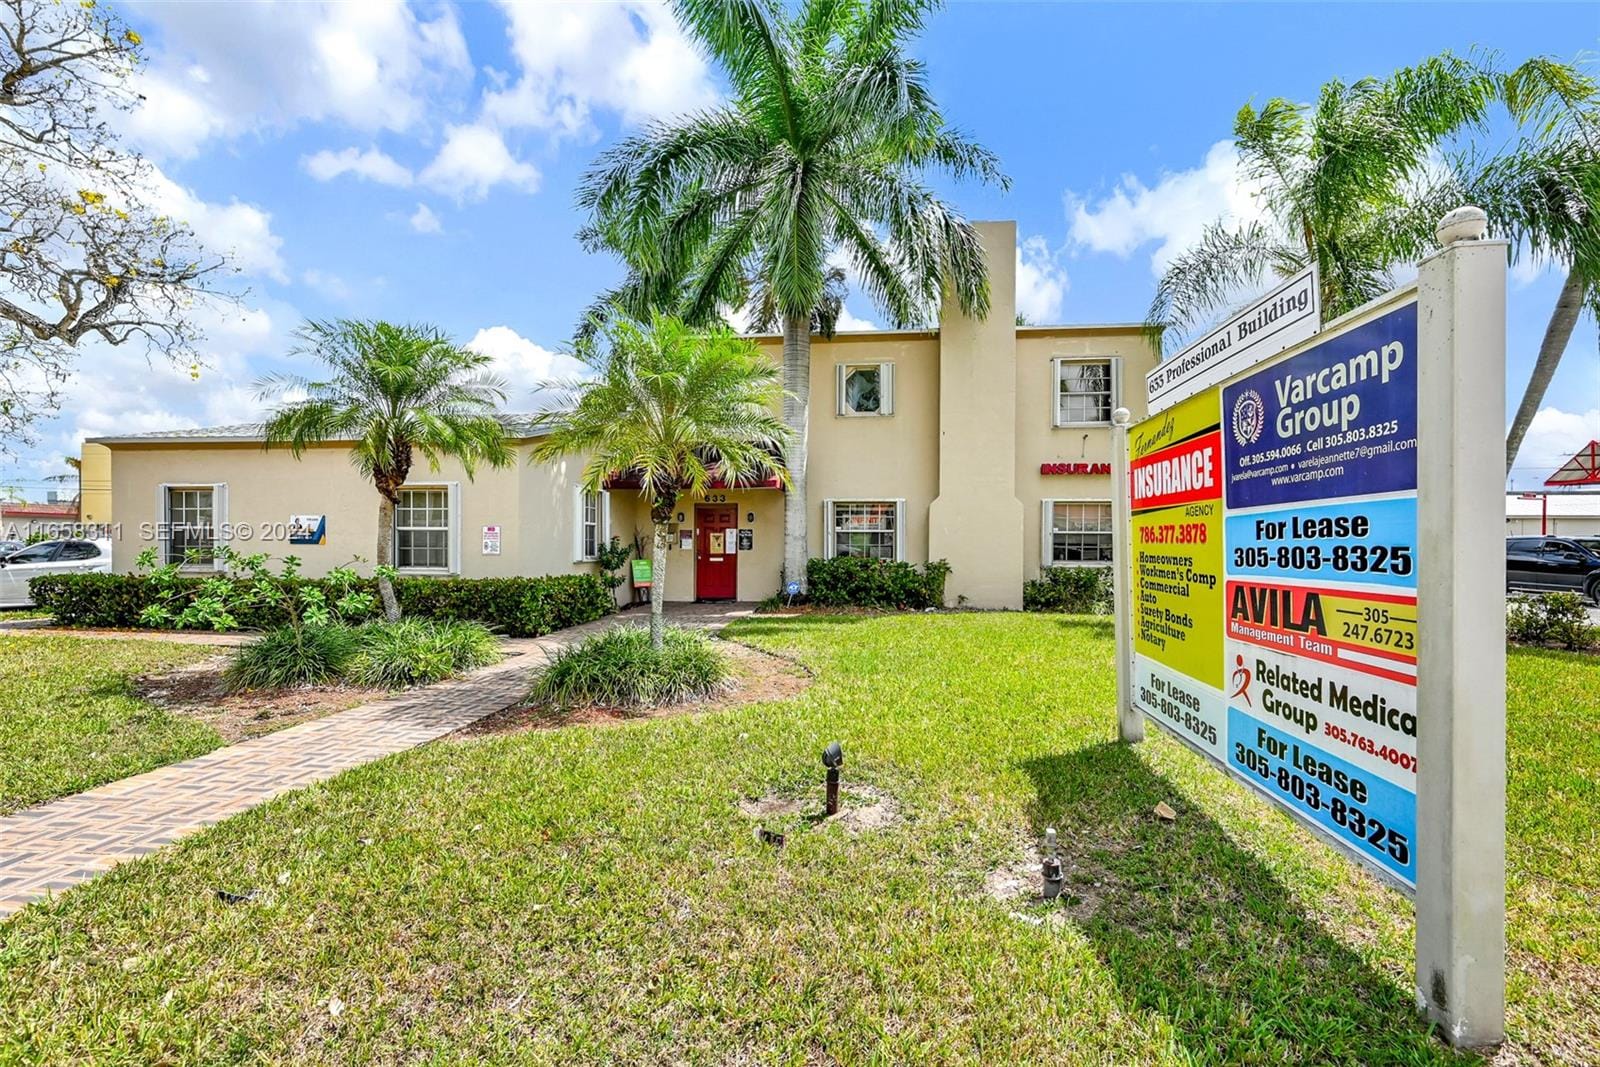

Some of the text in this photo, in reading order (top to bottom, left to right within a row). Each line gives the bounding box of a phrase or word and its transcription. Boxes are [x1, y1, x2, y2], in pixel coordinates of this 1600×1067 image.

[1166, 332, 1232, 384] Professional
[1237, 285, 1309, 342] Building
[1275, 340, 1404, 408] Varcamp
[1135, 412, 1175, 457] Fernandez
[1276, 393, 1361, 439] Group
[1231, 437, 1417, 484] jvarela@varcamp.com varelajeannette7@gmail.com
[1252, 444, 1302, 465] 305.594.0066
[1306, 437, 1324, 452] Cell
[1325, 420, 1399, 447] 305.803.8325
[1041, 463, 1111, 475] INSURAN
[1134, 447, 1214, 500] INSURANCE
[1271, 465, 1344, 487] www.varcamp.com
[1185, 504, 1214, 517] AGENCY
[1255, 515, 1369, 541] For Lease
[1139, 522, 1207, 544] 786.377.3878
[1139, 551, 1193, 567] Homeowners
[1234, 545, 1412, 576] 305-803-8325
[1139, 566, 1217, 590] Workmen's Comp
[1140, 578, 1190, 598] Commercial
[1140, 590, 1157, 604] Auto
[1140, 602, 1193, 628] Surety Bonds
[1231, 585, 1389, 637] AVILA 305
[1140, 616, 1186, 641] Agriculture
[1140, 629, 1166, 651] Notary
[1231, 622, 1415, 656] Management Team 247.6723
[1151, 673, 1200, 713] For Lease
[1256, 659, 1416, 738] Related Medica
[1140, 686, 1217, 746] 305-803-8325
[1262, 689, 1416, 773] Group 305.763.4007
[1257, 727, 1368, 804] For Lease
[1235, 742, 1410, 866] 305-803-8325
